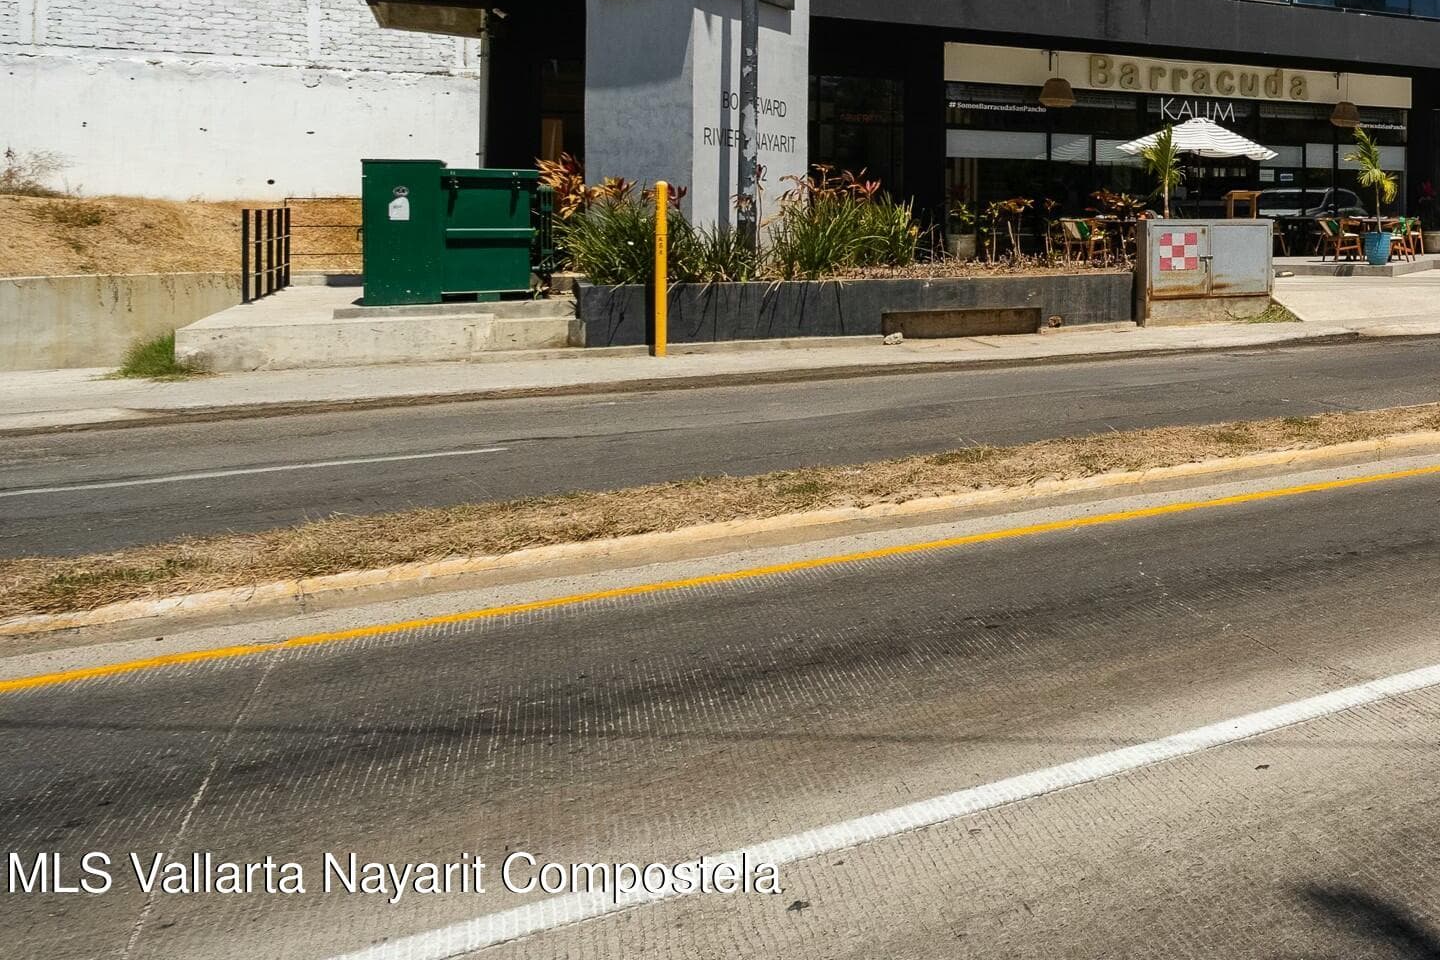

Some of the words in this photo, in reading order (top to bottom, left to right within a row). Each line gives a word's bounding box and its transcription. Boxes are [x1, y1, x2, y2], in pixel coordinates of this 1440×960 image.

[1089, 54, 1309, 101] Barracuda
[722, 91, 787, 118] BOEVARD
[703, 127, 740, 148] RIVIER
